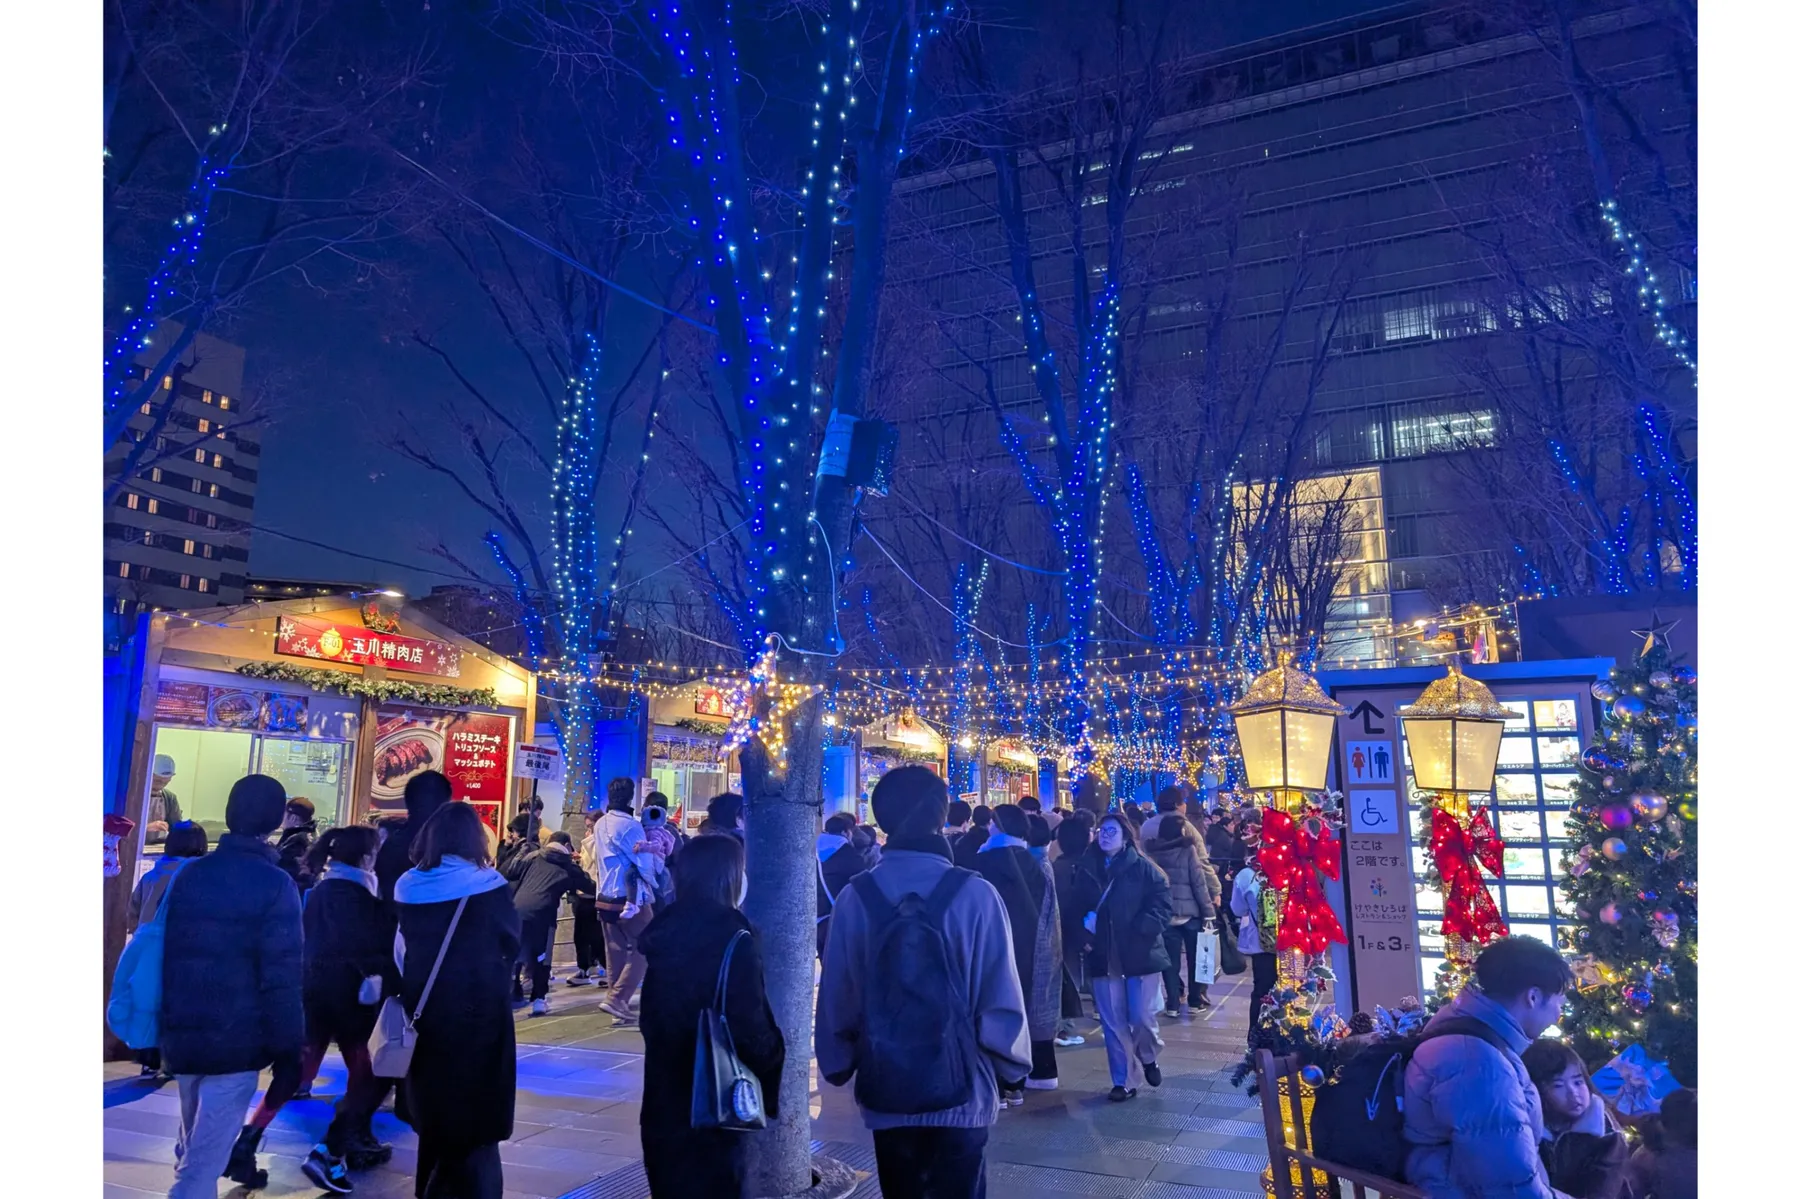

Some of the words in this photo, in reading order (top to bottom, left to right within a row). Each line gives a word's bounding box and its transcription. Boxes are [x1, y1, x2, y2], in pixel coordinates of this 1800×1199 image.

[350, 637, 424, 664] 玉川精肉店
[452, 732, 500, 744] ハラミステーキ
[455, 743, 496, 753] トリュフソース
[454, 759, 496, 768] マッシュポテト
[525, 759, 550, 770] 最後尾
[1350, 840, 1383, 851] ここは
[1356, 855, 1405, 867] 2階です。
[1354, 903, 1407, 913] けやきひろば
